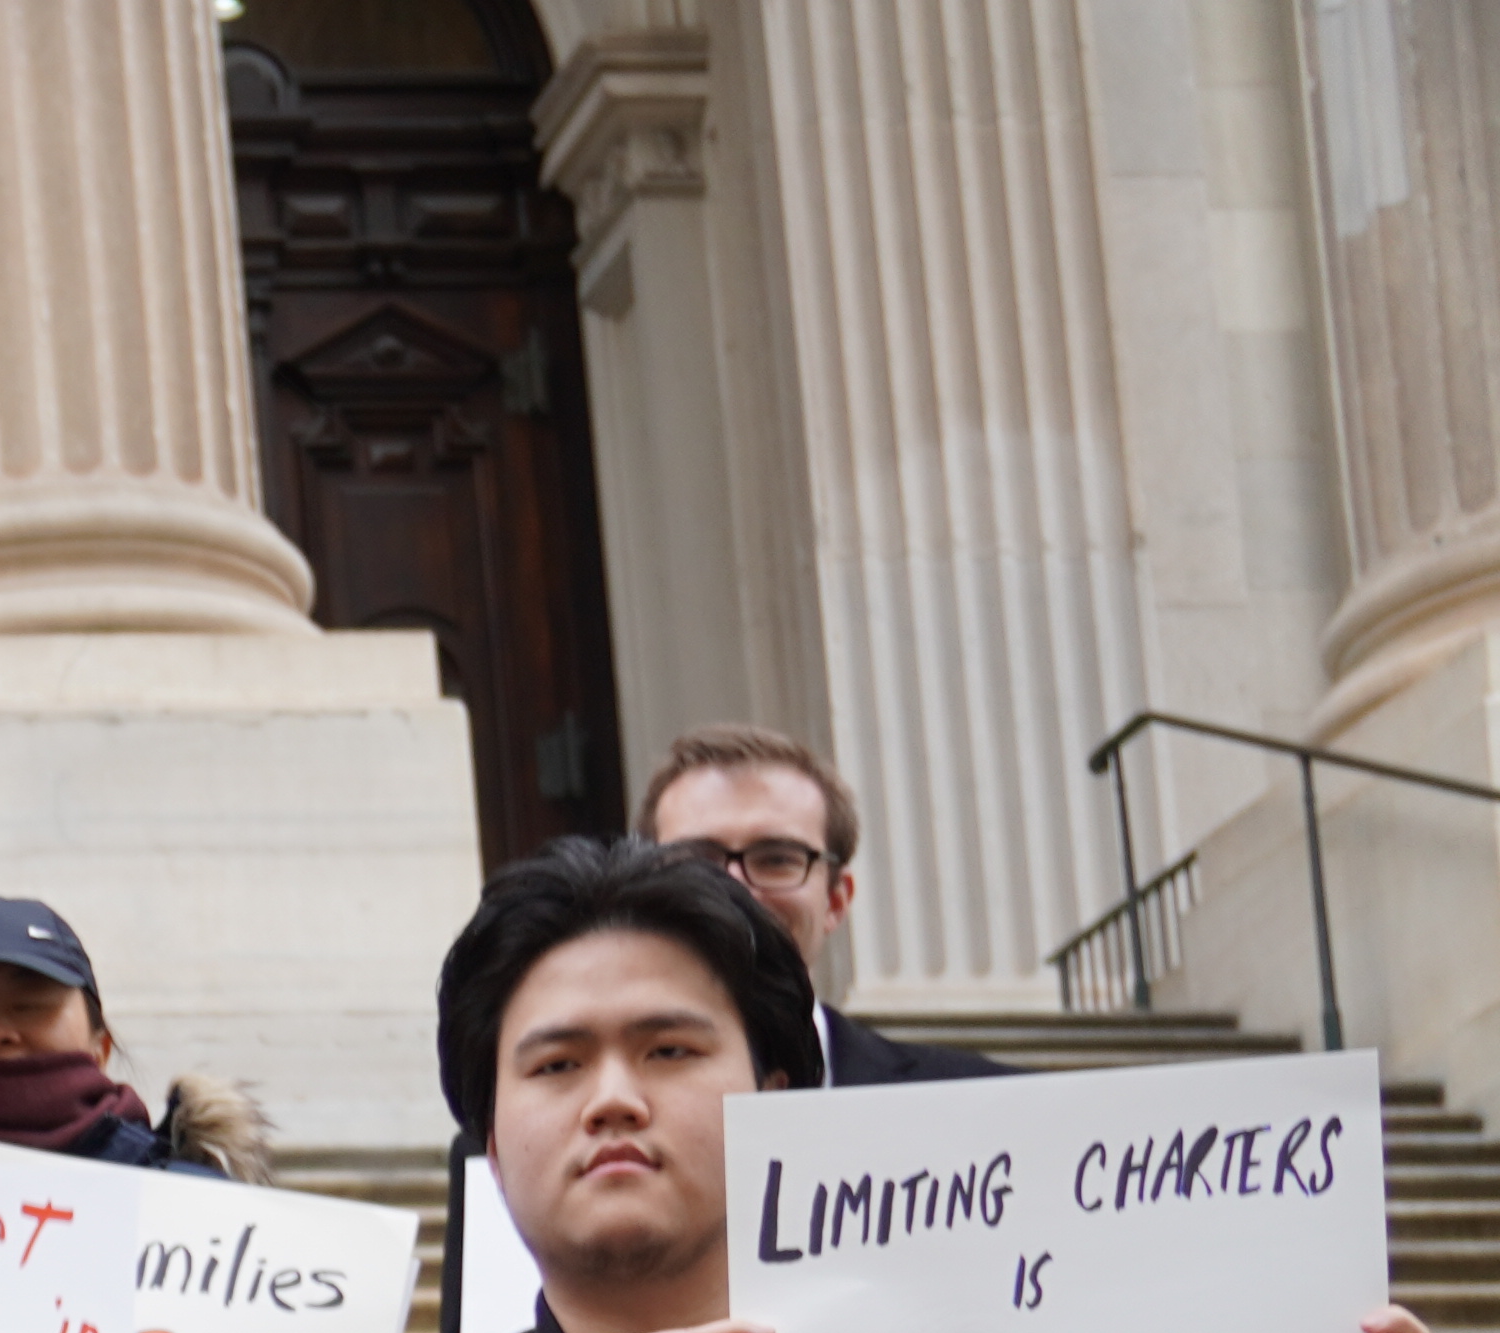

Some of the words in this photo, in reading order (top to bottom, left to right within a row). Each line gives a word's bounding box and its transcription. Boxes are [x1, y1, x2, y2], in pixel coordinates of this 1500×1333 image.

[756, 1150, 1014, 1264] LIMITING
[1074, 1115, 1344, 1213] CHARTERS
[134, 1223, 348, 1313] milies
[1011, 1250, 1054, 1311] IS
